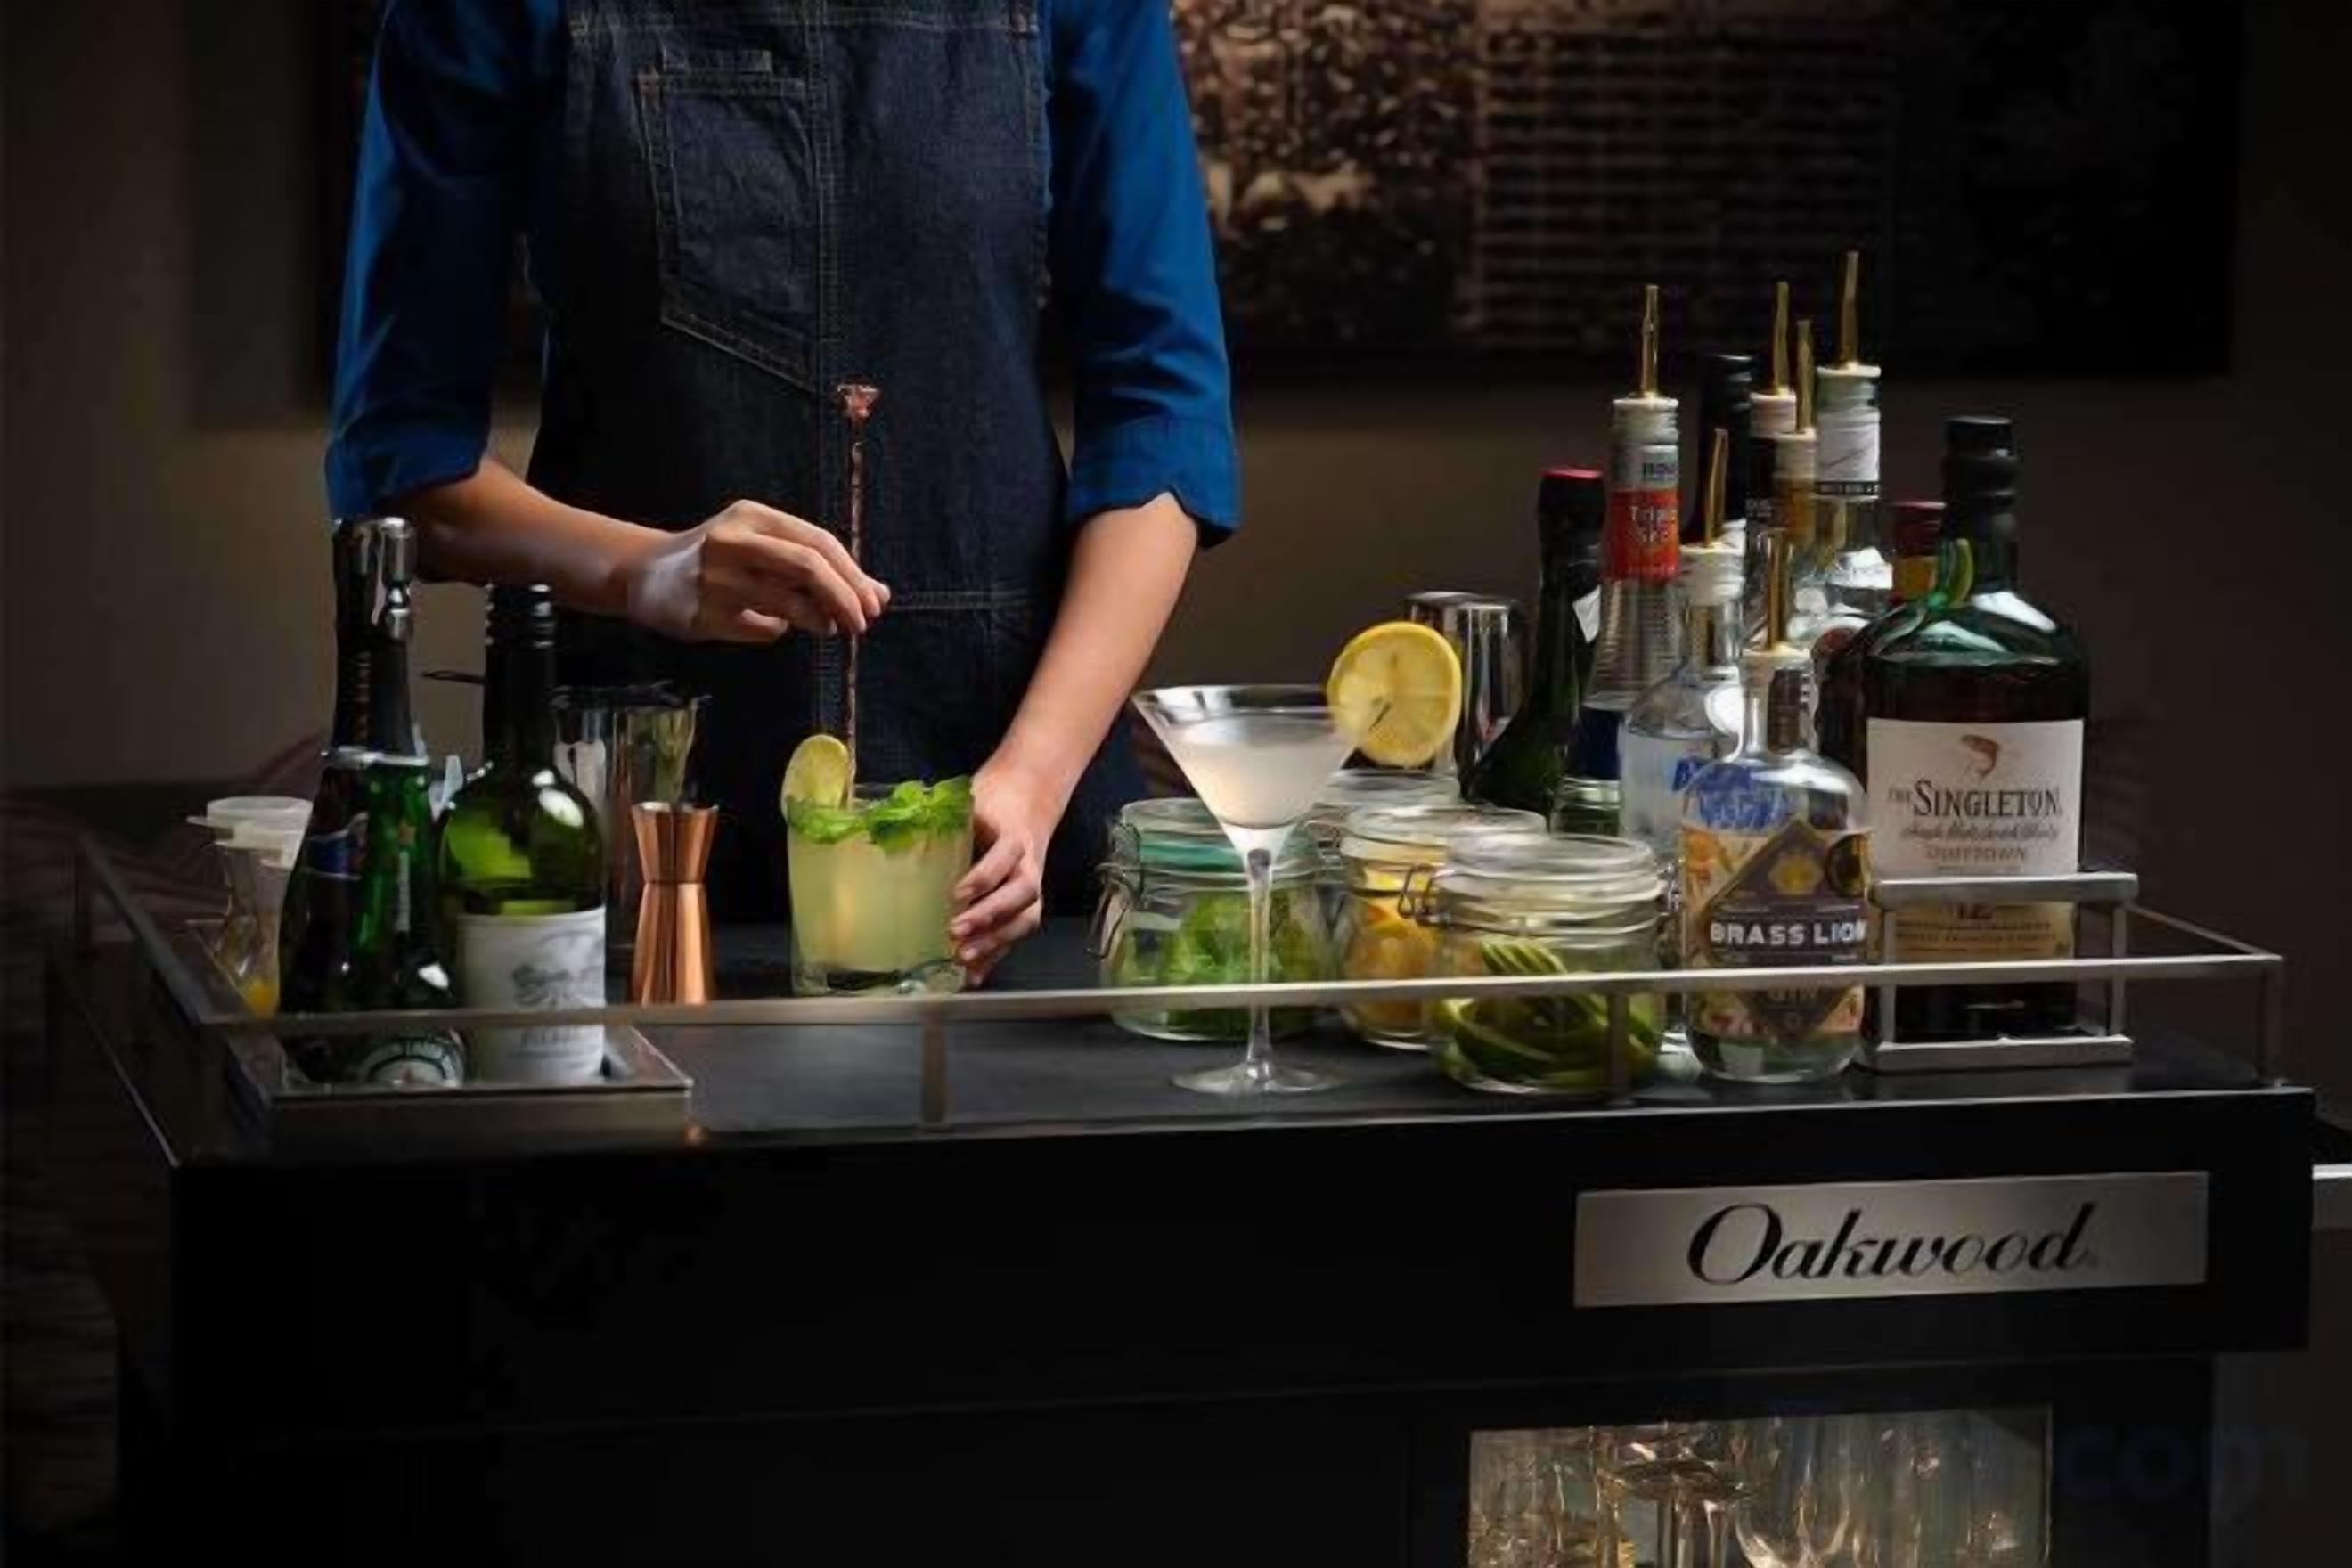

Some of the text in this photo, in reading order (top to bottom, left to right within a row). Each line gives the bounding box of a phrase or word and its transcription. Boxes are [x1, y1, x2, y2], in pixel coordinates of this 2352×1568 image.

[1913, 778, 2062, 817] SINGLETON
[1710, 920, 1806, 946] BRASS
[1686, 1201, 2095, 1286] Oakwood
